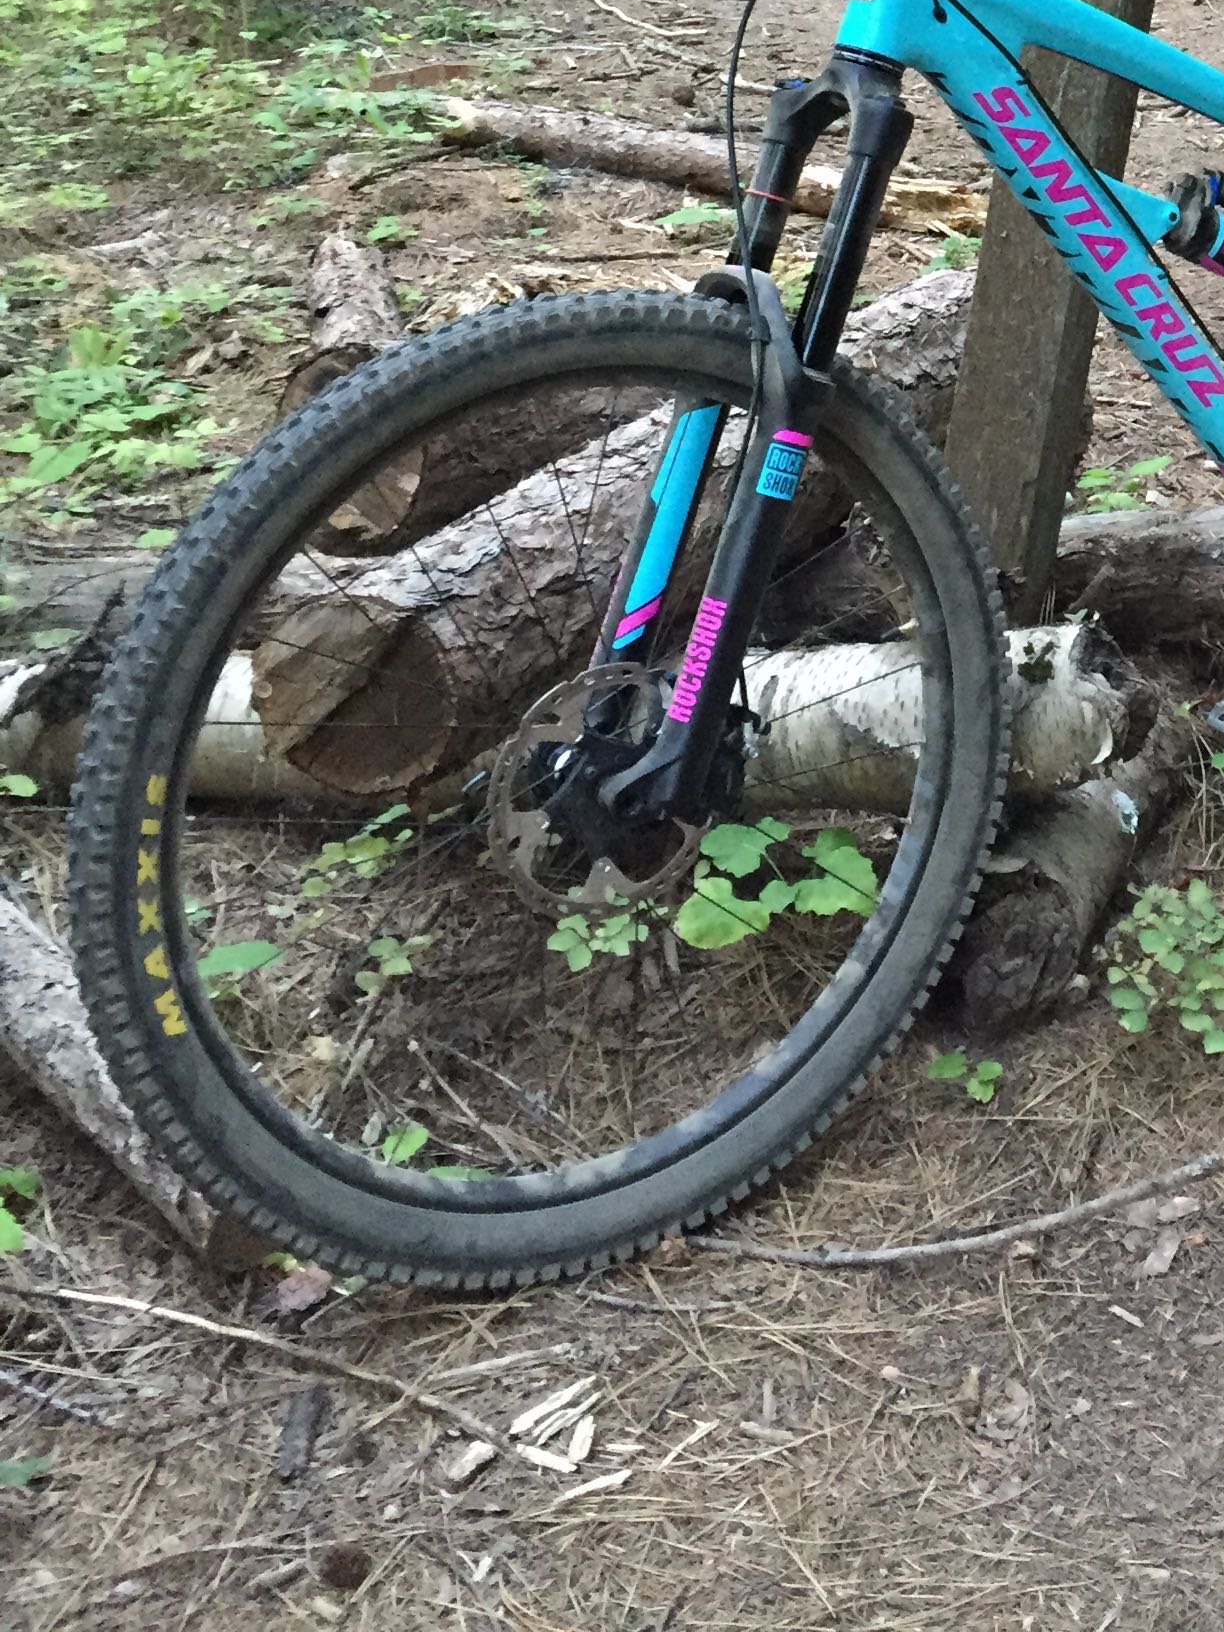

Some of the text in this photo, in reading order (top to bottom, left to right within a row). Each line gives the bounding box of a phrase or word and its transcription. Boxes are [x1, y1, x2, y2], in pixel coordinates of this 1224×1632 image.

[972, 86, 1129, 273] SANTA
[762, 471, 797, 497] SHOX
[767, 448, 804, 474] ROCK
[667, 595, 728, 724] ROCKSHOX
[136, 773, 188, 1037] MAXXIS
